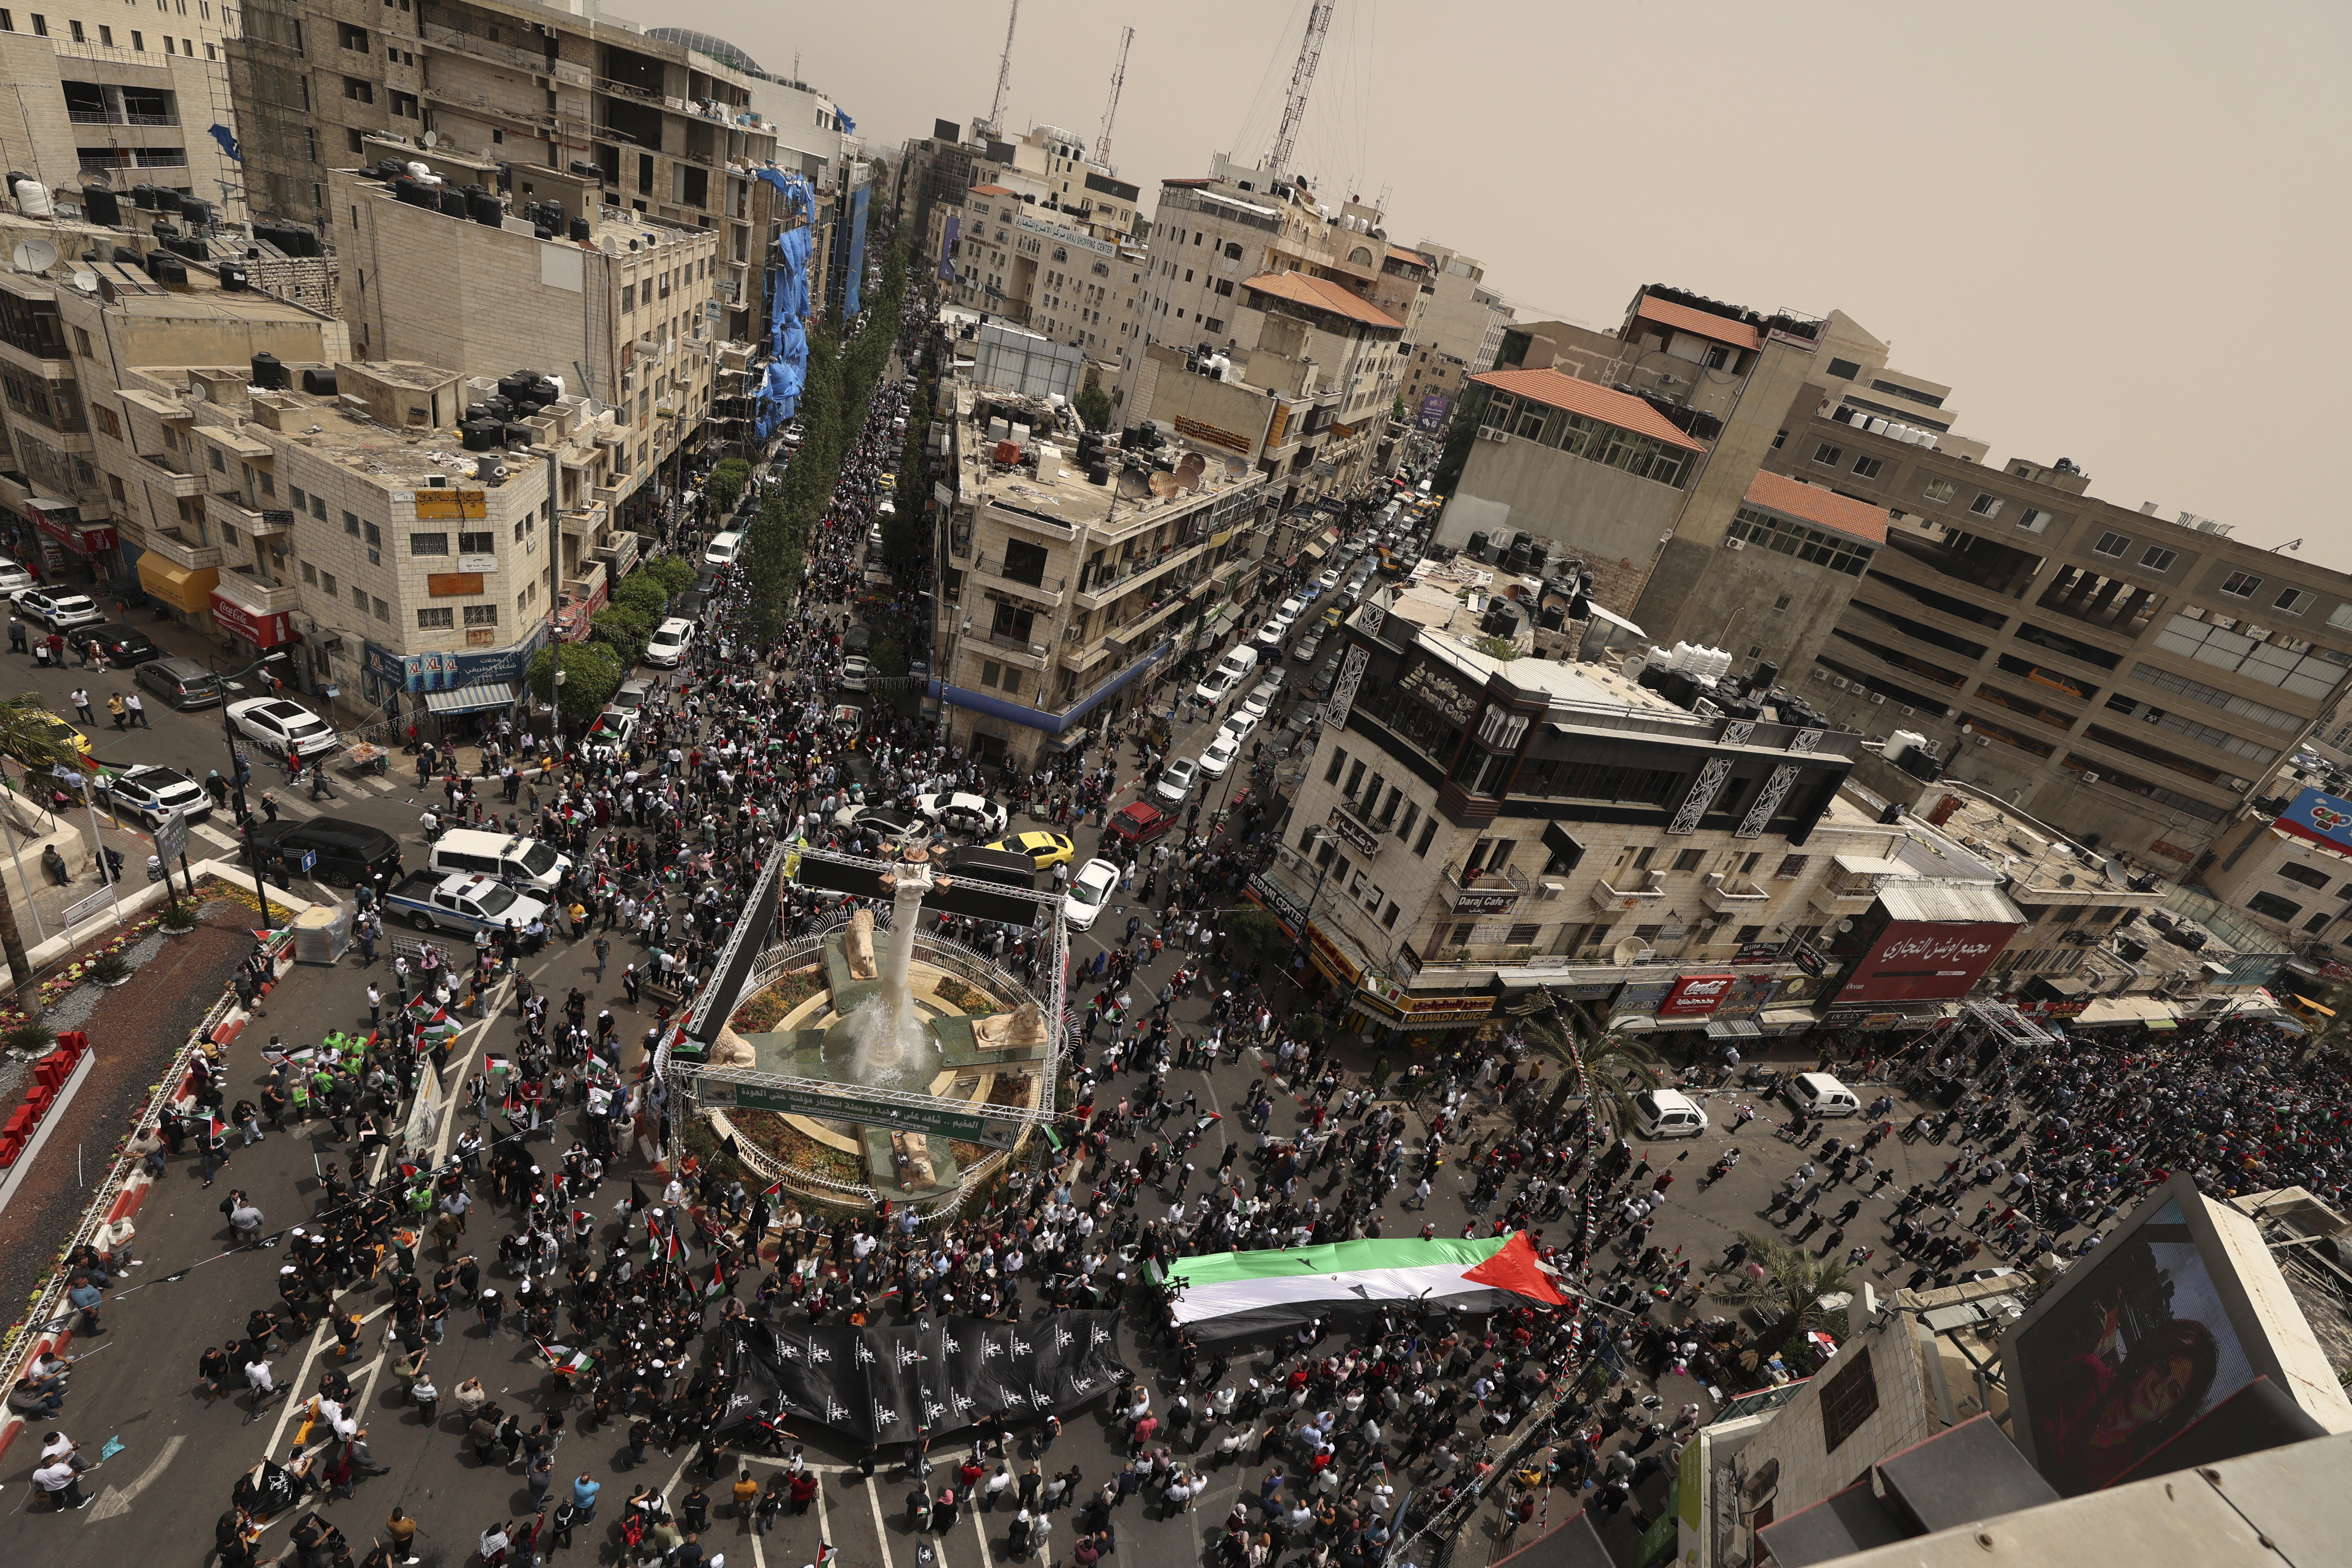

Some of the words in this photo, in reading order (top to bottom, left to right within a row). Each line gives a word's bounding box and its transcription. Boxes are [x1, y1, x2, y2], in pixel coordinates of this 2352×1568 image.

[1016, 218, 1035, 229] التجاري
[1035, 224, 1052, 234] الاعرج
[1052, 229, 1065, 238] مركز
[1066, 233, 1076, 243] ARAJ
[1077, 236, 1096, 249] SHOPPING
[1097, 243, 1112, 254] CENTER
[417, 492, 437, 504] العربي
[466, 492, 484, 502] مركز
[1318, 501, 1343, 513] البكري
[220, 601, 248, 625] Coca-Cola
[242, 632, 257, 643] مطعم
[370, 651, 383, 671] XL
[384, 658, 399, 669] محلات
[425, 657, 441, 671] XL
[444, 659, 458, 671] XL
[408, 662, 421, 674] XL
[463, 665, 493, 674] الطريفي
[1425, 672, 1458, 700] كافيه
[1419, 686, 1447, 711] Daraj
[1456, 693, 1477, 711] درج
[2313, 807, 2350, 825] OZMO
[1340, 821, 1366, 847] كافيه
[1347, 837, 1356, 849] Daraj
[1248, 872, 1277, 901] SUDANI
[1358, 879, 1367, 888] العربي
[1366, 885, 1376, 896] المركز
[1458, 897, 1485, 908] Daraj
[1487, 897, 1504, 905] Cafe
[69, 911, 83, 921] Al-Manara
[83, 906, 93, 915] Square
[1743, 943, 1761, 952] Elite
[1761, 943, 1779, 951] Smile
[1880, 937, 1933, 963] التجاري
[1952, 943, 1991, 962] مجمع
[1308, 943, 1327, 963] SILWADI
[1326, 961, 1341, 978] JUICE
[1799, 947, 1811, 956] Elite
[1810, 953, 1823, 968] Smile
[1683, 980, 1727, 995] Coca-Cola
[1462, 1000, 1491, 1010] عصير
[1407, 1013, 1454, 1023] SILWADI
[1455, 1012, 1490, 1021] JUICE
[741, 1087, 767, 1100] العودة
[768, 1090, 785, 1101] حتى
[788, 1093, 813, 1107] مؤقتة
[814, 1096, 842, 1111] إنتظار
[844, 1101, 873, 1114] ومحطة
[903, 1110, 920, 1121] على
[921, 1112, 941, 1127] شاهد
[952, 1115, 979, 1130] المخيم
